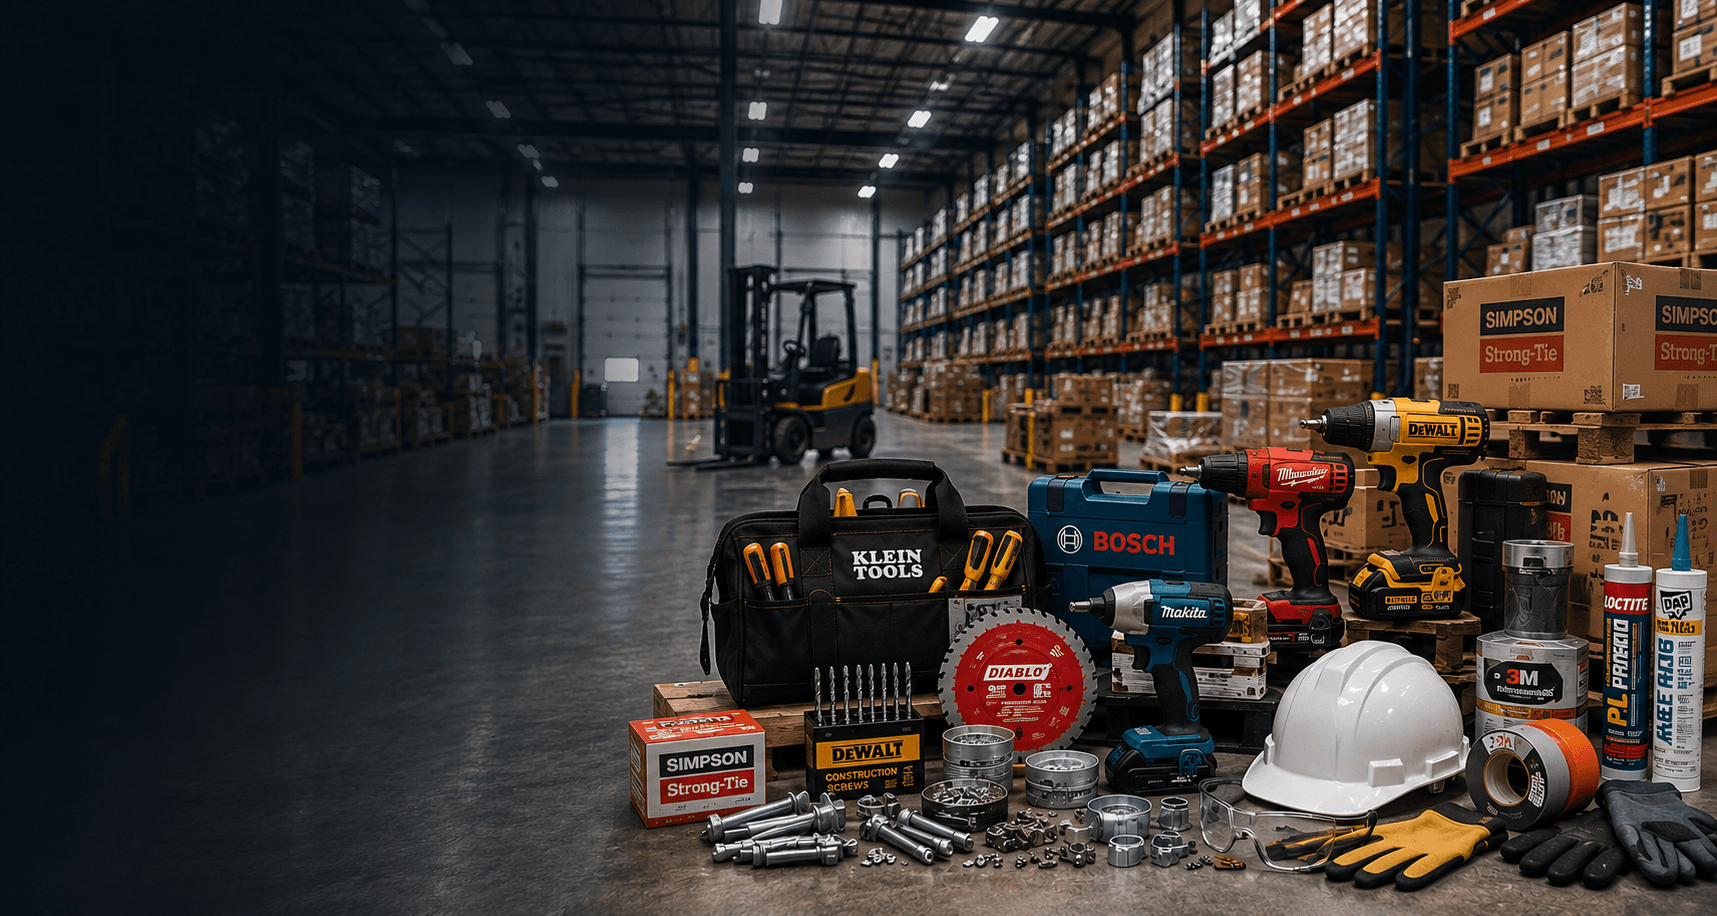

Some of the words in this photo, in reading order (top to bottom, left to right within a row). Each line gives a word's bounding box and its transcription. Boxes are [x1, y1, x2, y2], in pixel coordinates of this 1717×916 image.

[1486, 307, 1557, 328] SIMPSON
[1485, 343, 1558, 367] Strong-Tie
[1093, 530, 1175, 556] BOSCH
[851, 549, 922, 565] KLEIN
[853, 564, 924, 580] TOOLS
[1604, 595, 1649, 612] LOCTITE
[1663, 595, 1689, 611] DAP
[1160, 605, 1208, 619] Makita
[988, 667, 1043, 679] DIABLO
[1506, 668, 1539, 686] 3M
[831, 740, 904, 764] DEWALT
[666, 750, 748, 773] SIMPSON
[825, 767, 898, 782] CONSTRUCTION
[667, 776, 749, 798] Strong-Tie
